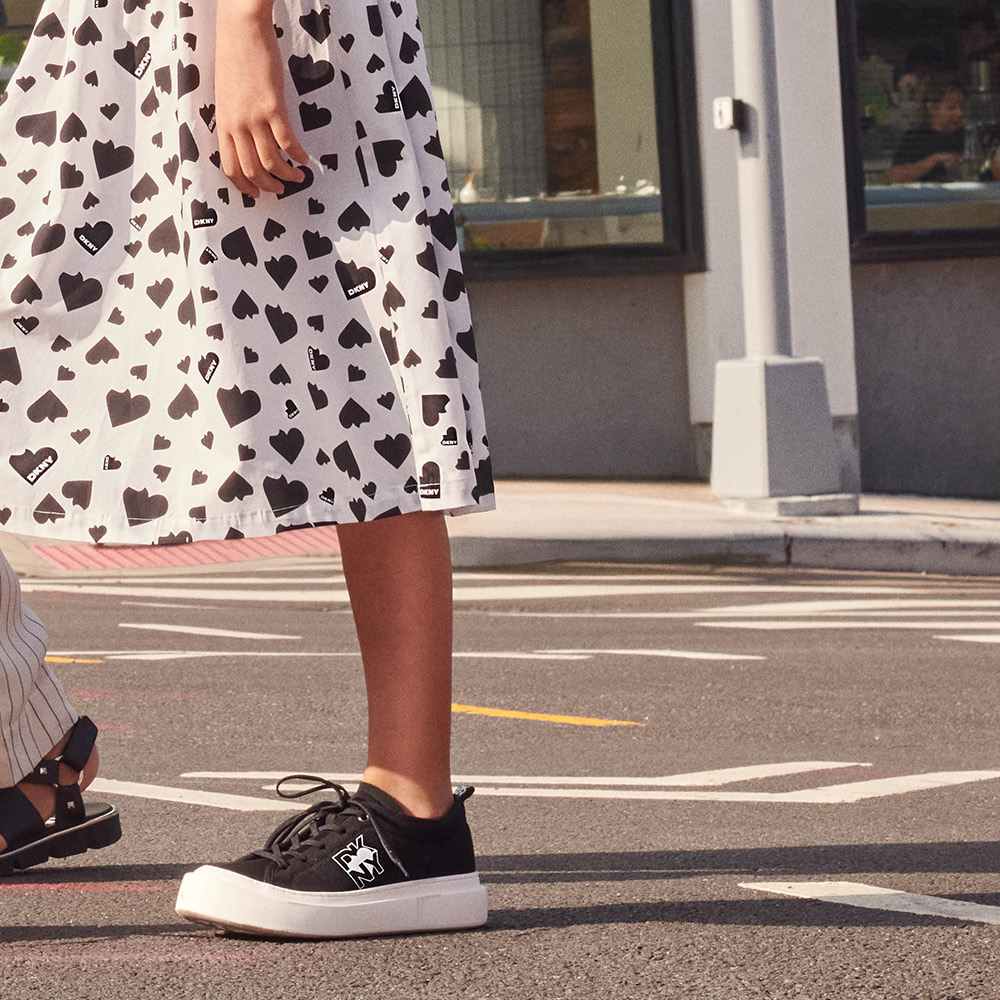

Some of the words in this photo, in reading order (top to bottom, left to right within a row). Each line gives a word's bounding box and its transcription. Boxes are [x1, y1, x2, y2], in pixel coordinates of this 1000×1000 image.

[391, 86, 400, 109] DKNY
[194, 218, 214, 226] DKNY
[79, 234, 98, 252] DKNY
[348, 281, 369, 296] DKNY
[204, 359, 217, 380] DKNY
[308, 348, 317, 370] DKNY
[26, 455, 54, 480] DKNY
